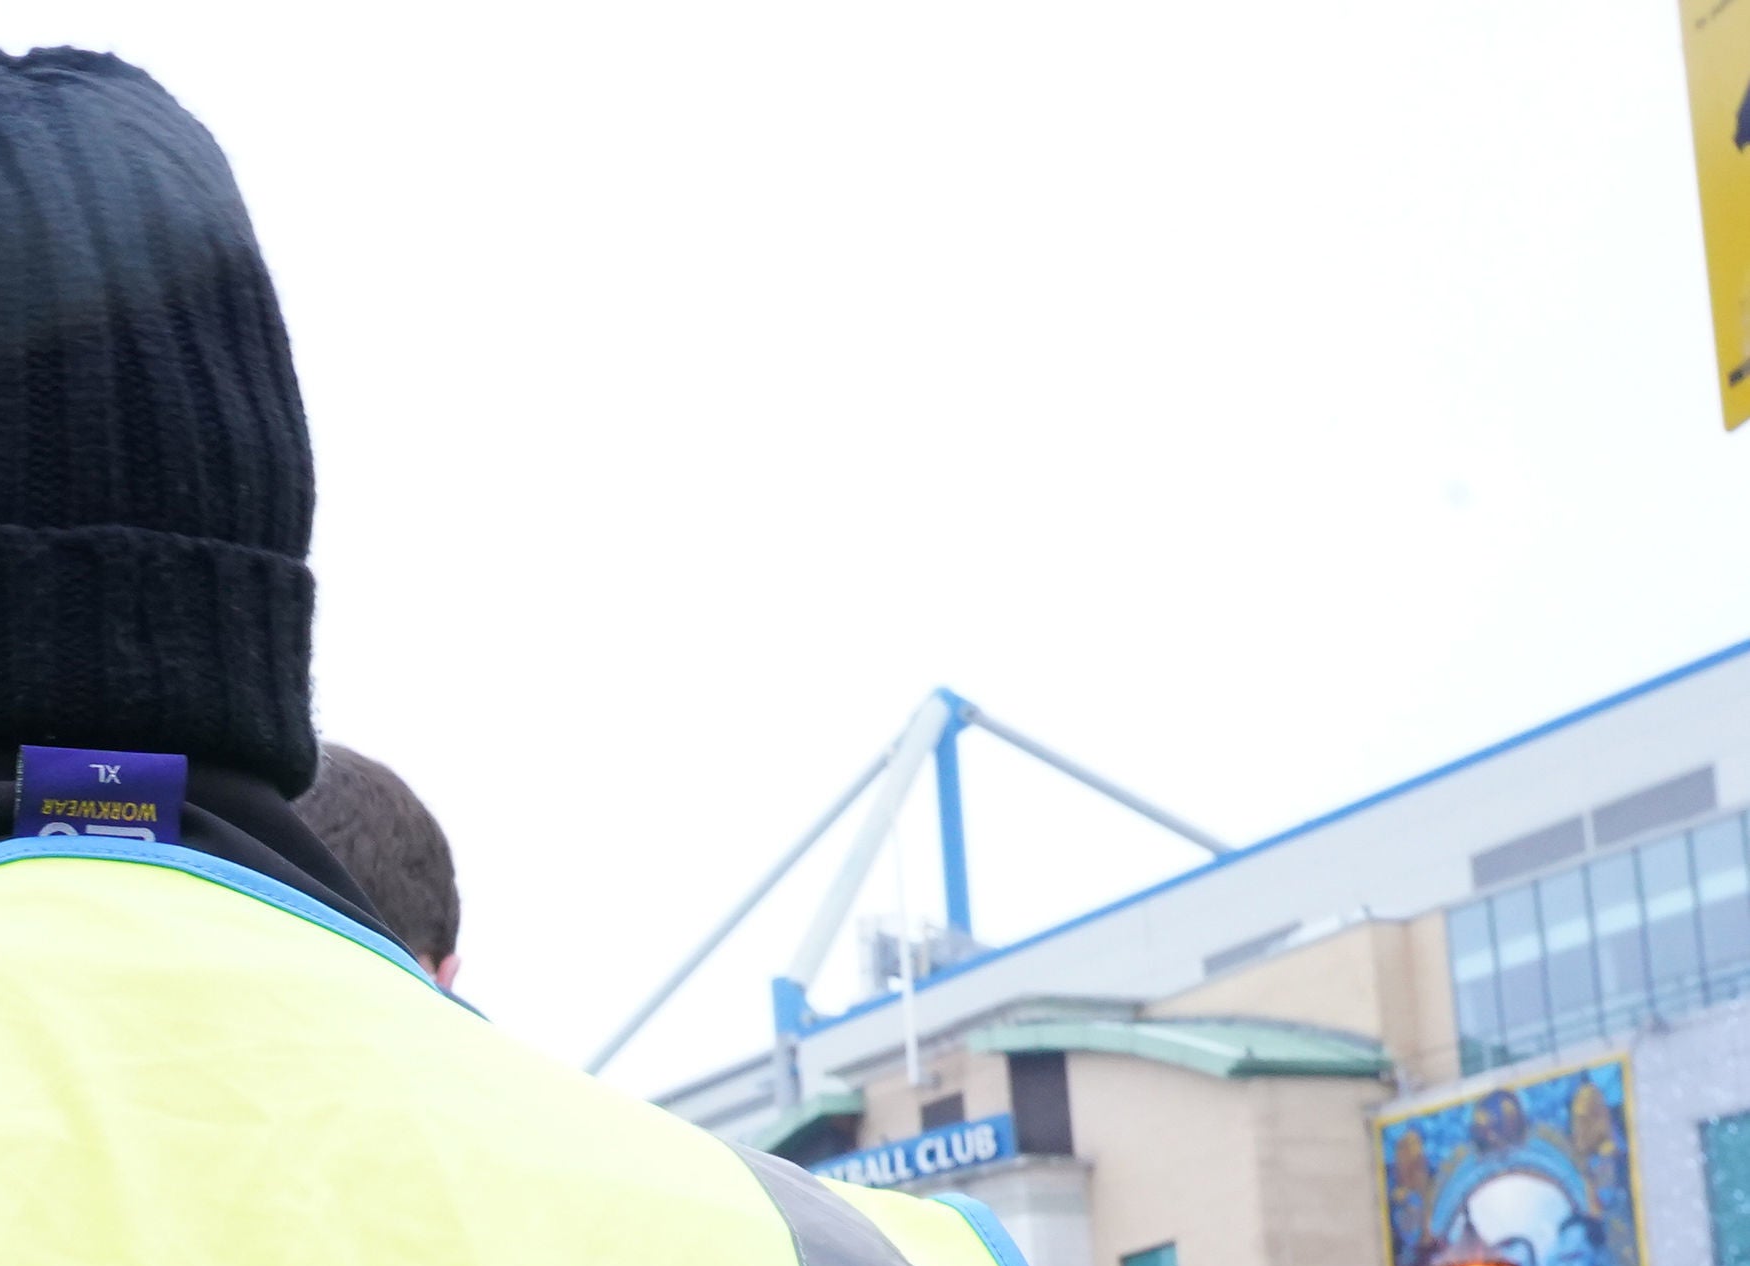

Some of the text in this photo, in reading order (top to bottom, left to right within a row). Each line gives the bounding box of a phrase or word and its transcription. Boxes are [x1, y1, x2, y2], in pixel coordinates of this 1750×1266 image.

[88, 763, 122, 785] XL
[41, 798, 158, 822] WORKWEAR
[916, 1124, 998, 1173] CLUB
